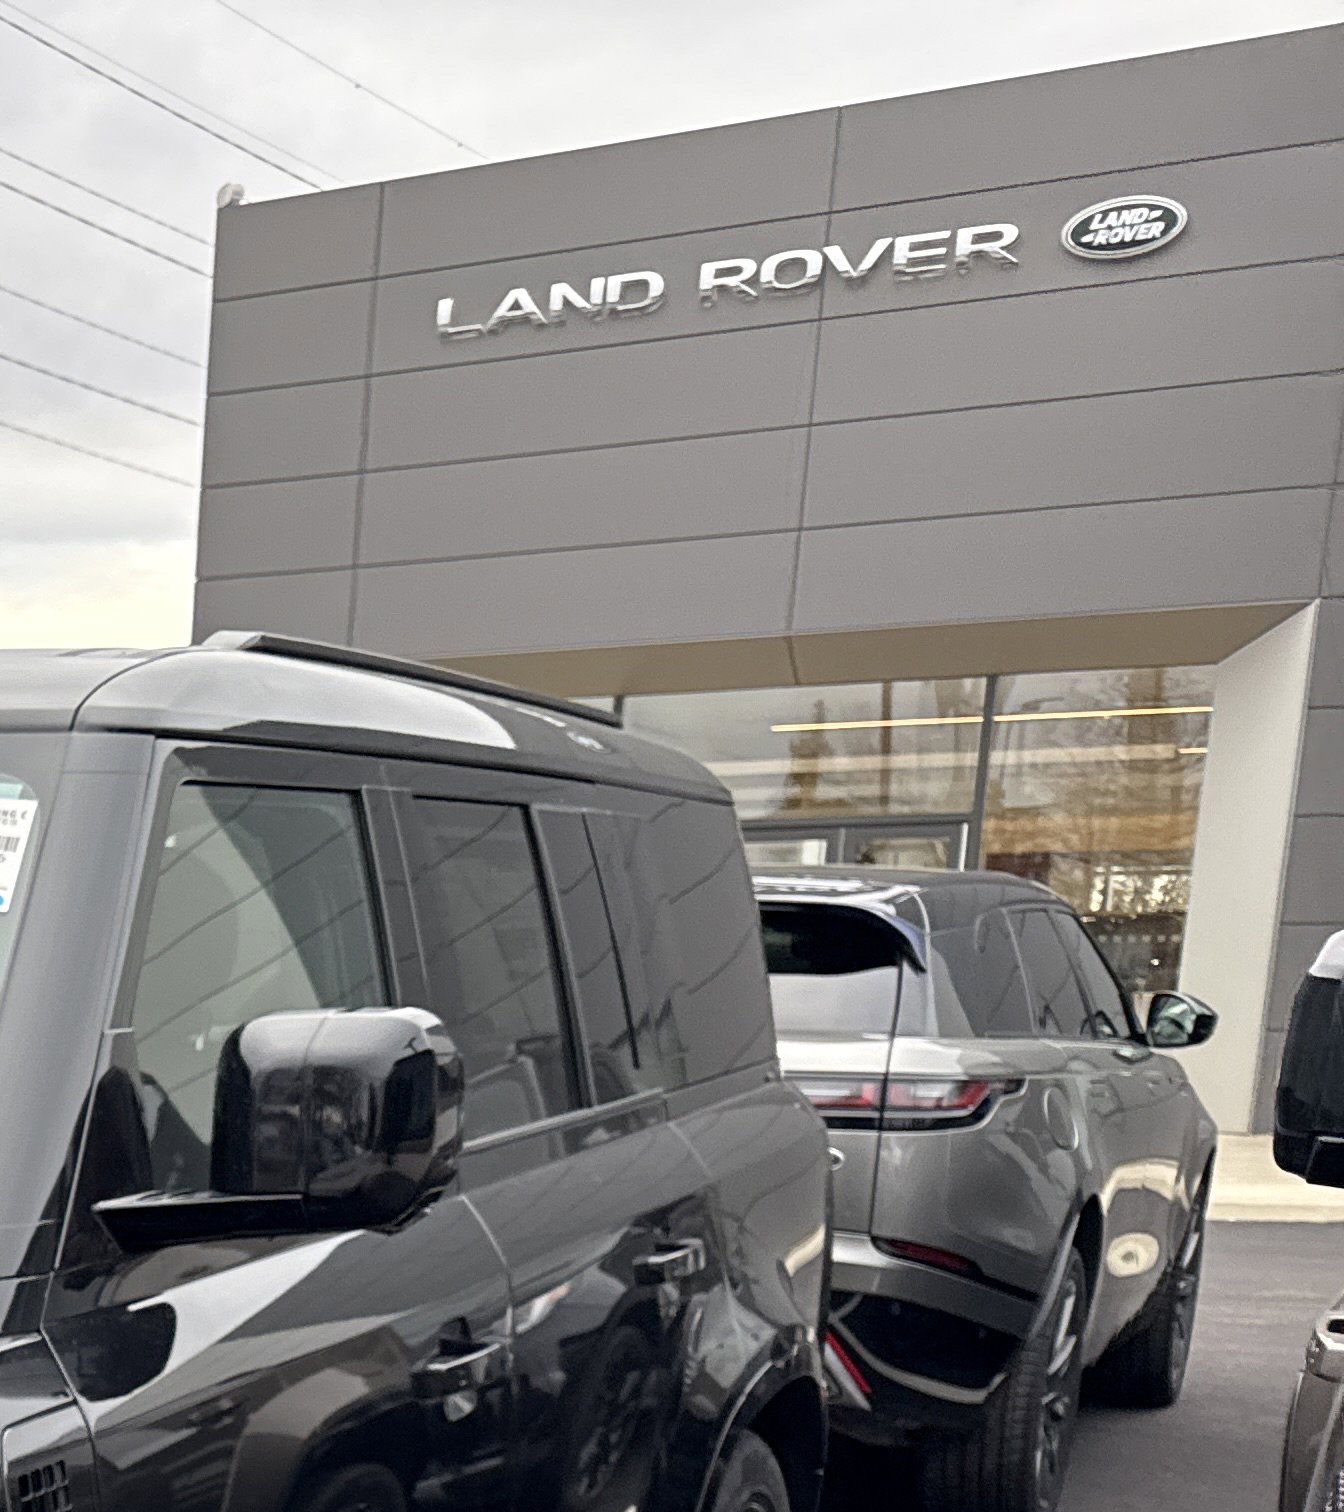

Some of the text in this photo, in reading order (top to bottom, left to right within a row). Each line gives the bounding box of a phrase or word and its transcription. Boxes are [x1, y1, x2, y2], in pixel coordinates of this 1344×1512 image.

[1089, 207, 1150, 231] LAND
[1092, 221, 1166, 247] ROVER
[436, 221, 1021, 336] LAND ROVER
